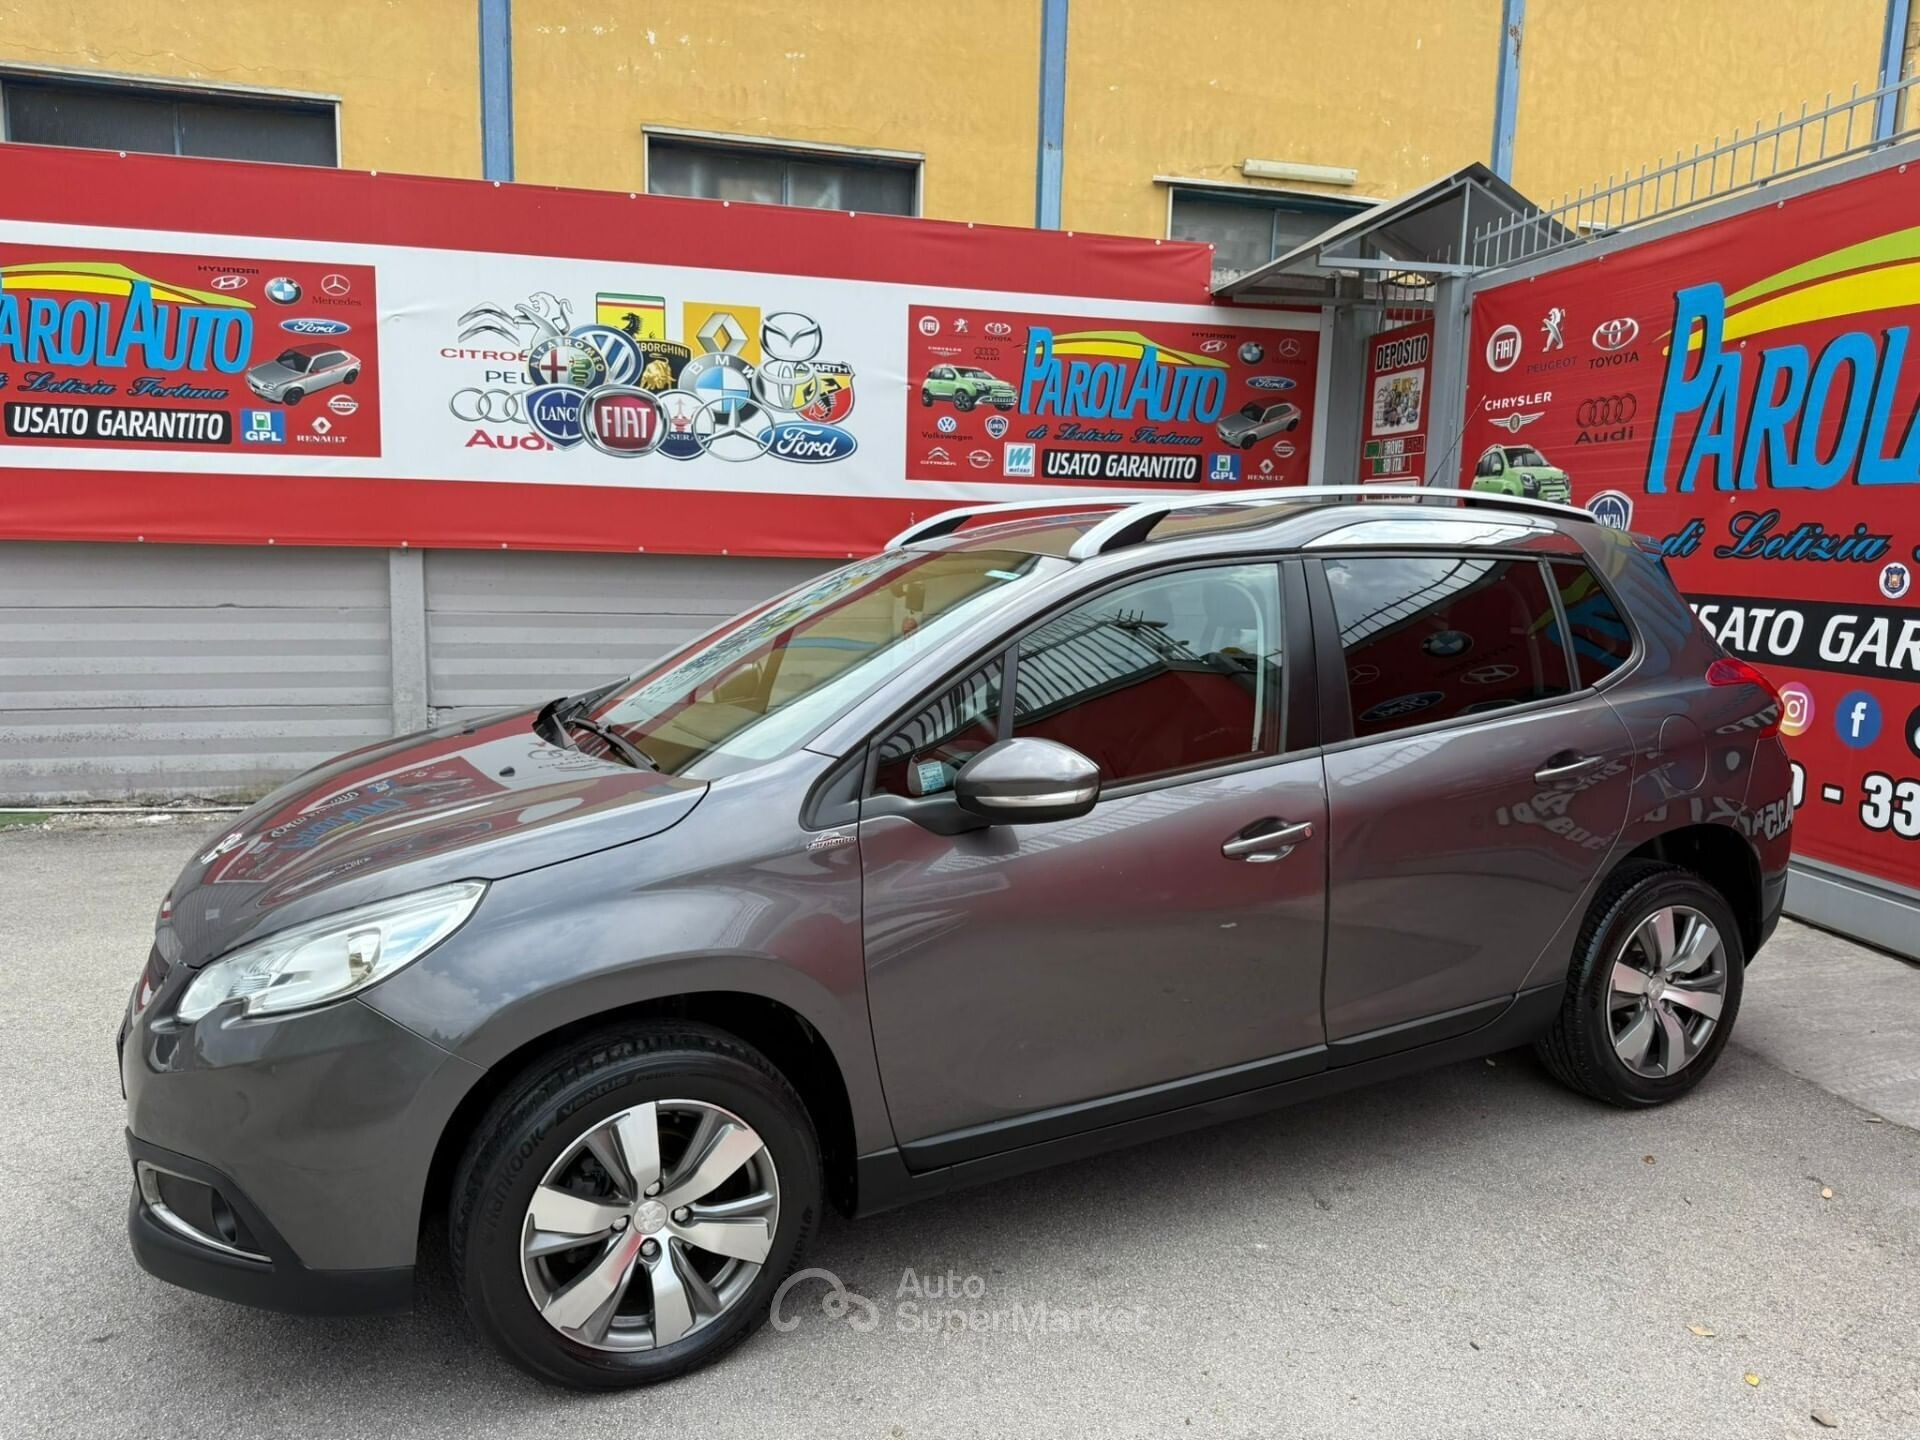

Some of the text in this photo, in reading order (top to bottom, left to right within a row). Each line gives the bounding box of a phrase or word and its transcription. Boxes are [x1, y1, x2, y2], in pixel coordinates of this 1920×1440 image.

[197, 264, 260, 275] HYUNDAI
[311, 295, 363, 307] Mercedes
[294, 319, 336, 335] Ford
[530, 340, 557, 370] ALFA
[1376, 334, 1429, 371] DEPOSITO
[1494, 337, 1516, 361] FIAT
[1588, 350, 1640, 370] TOYOTA
[1526, 356, 1578, 374] PEUGEOT
[17, 371, 117, 396] Letizia
[126, 376, 230, 400] Fortuna
[1484, 391, 1552, 411] CHRYSLER
[13, 406, 224, 441] USATO GARANTITO
[600, 405, 651, 440] FIAT
[245, 430, 282, 442] GPL
[296, 434, 348, 444] RENAULT
[776, 426, 837, 458] Ford
[921, 431, 974, 442] Volkswagen
[1025, 422, 1204, 446] di Letizia Fortuna
[1574, 425, 1634, 445] Audi
[1047, 451, 1197, 480] USATO GARANTITO
[1210, 470, 1237, 481] GPL
[1714, 508, 1894, 563] Letizia
[1690, 602, 1805, 657] SATO
